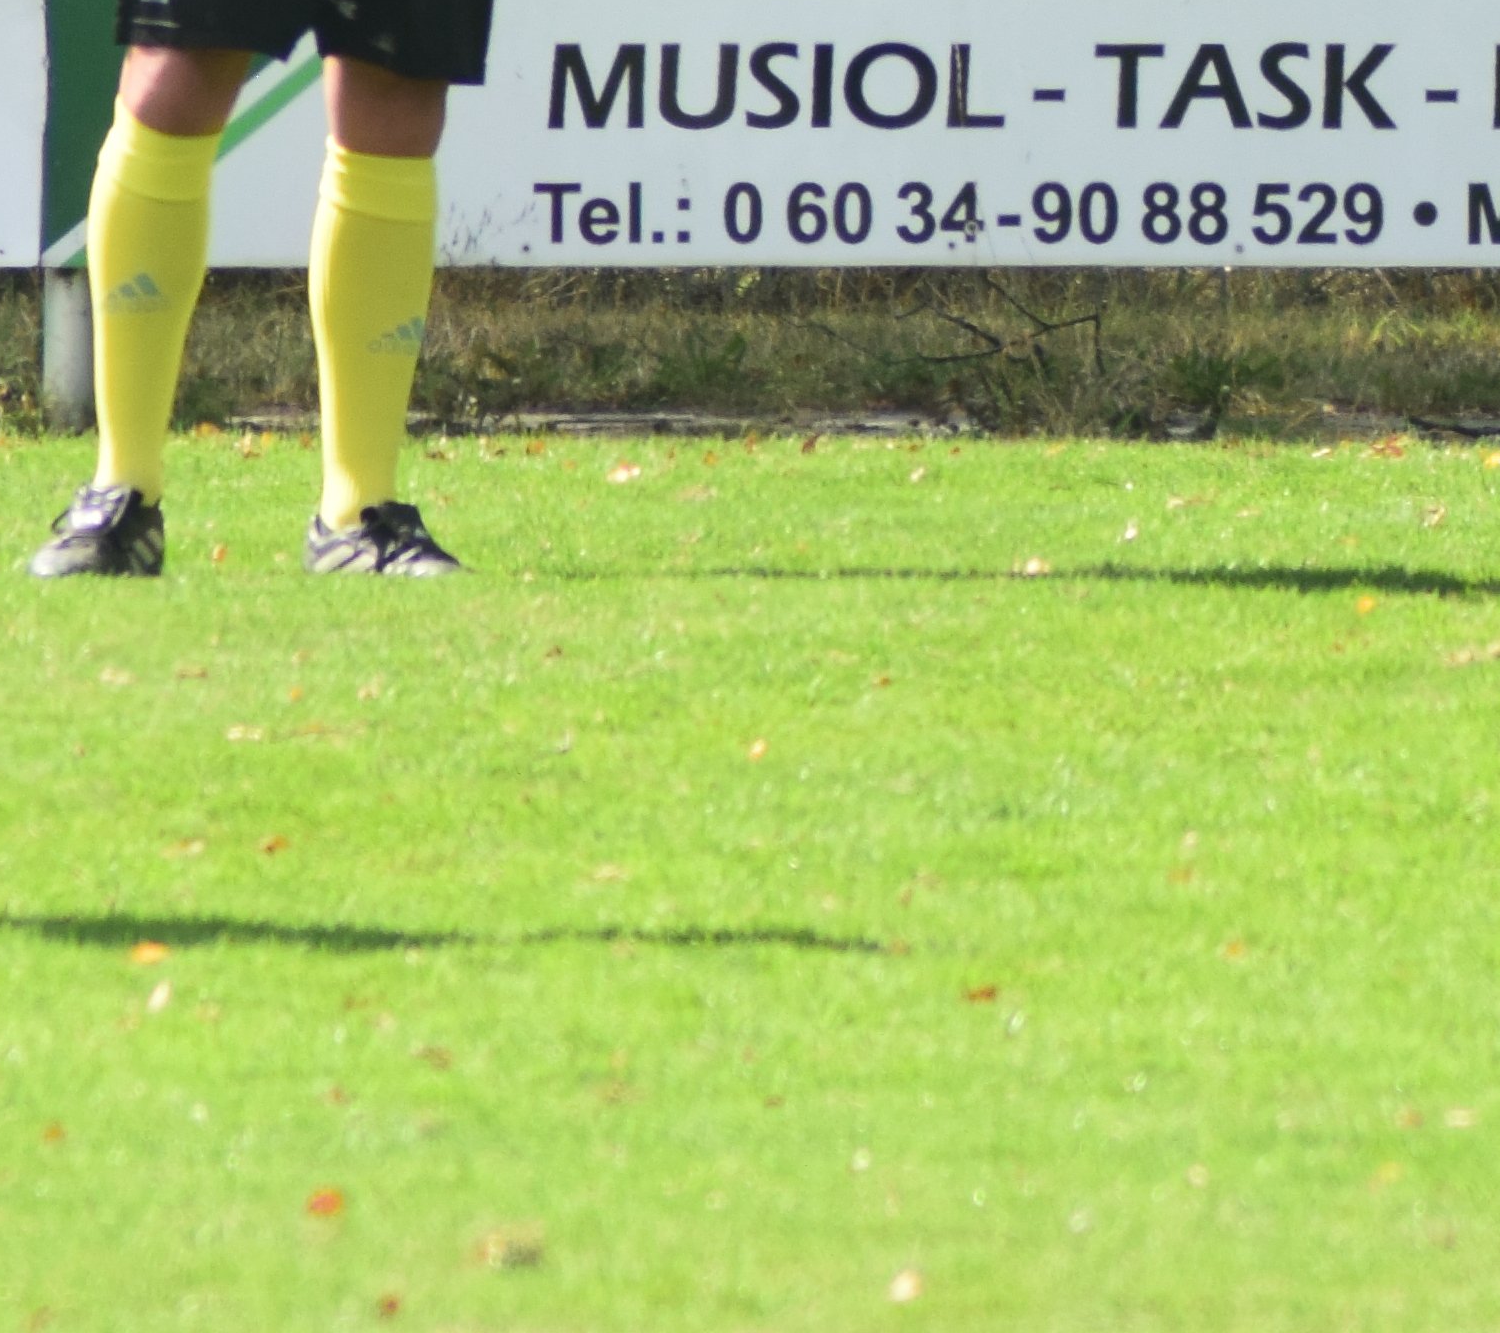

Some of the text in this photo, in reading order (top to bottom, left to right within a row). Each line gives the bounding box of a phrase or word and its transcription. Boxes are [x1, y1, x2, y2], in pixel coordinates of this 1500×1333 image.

[548, 42, 1005, 131] MUSIOL
[1095, 42, 1397, 131] TASK
[533, 181, 691, 245] Tel.:
[723, 181, 763, 245] 0
[786, 181, 873, 245] 60
[1141, 181, 1229, 245] 88
[1251, 181, 1384, 245] 529
